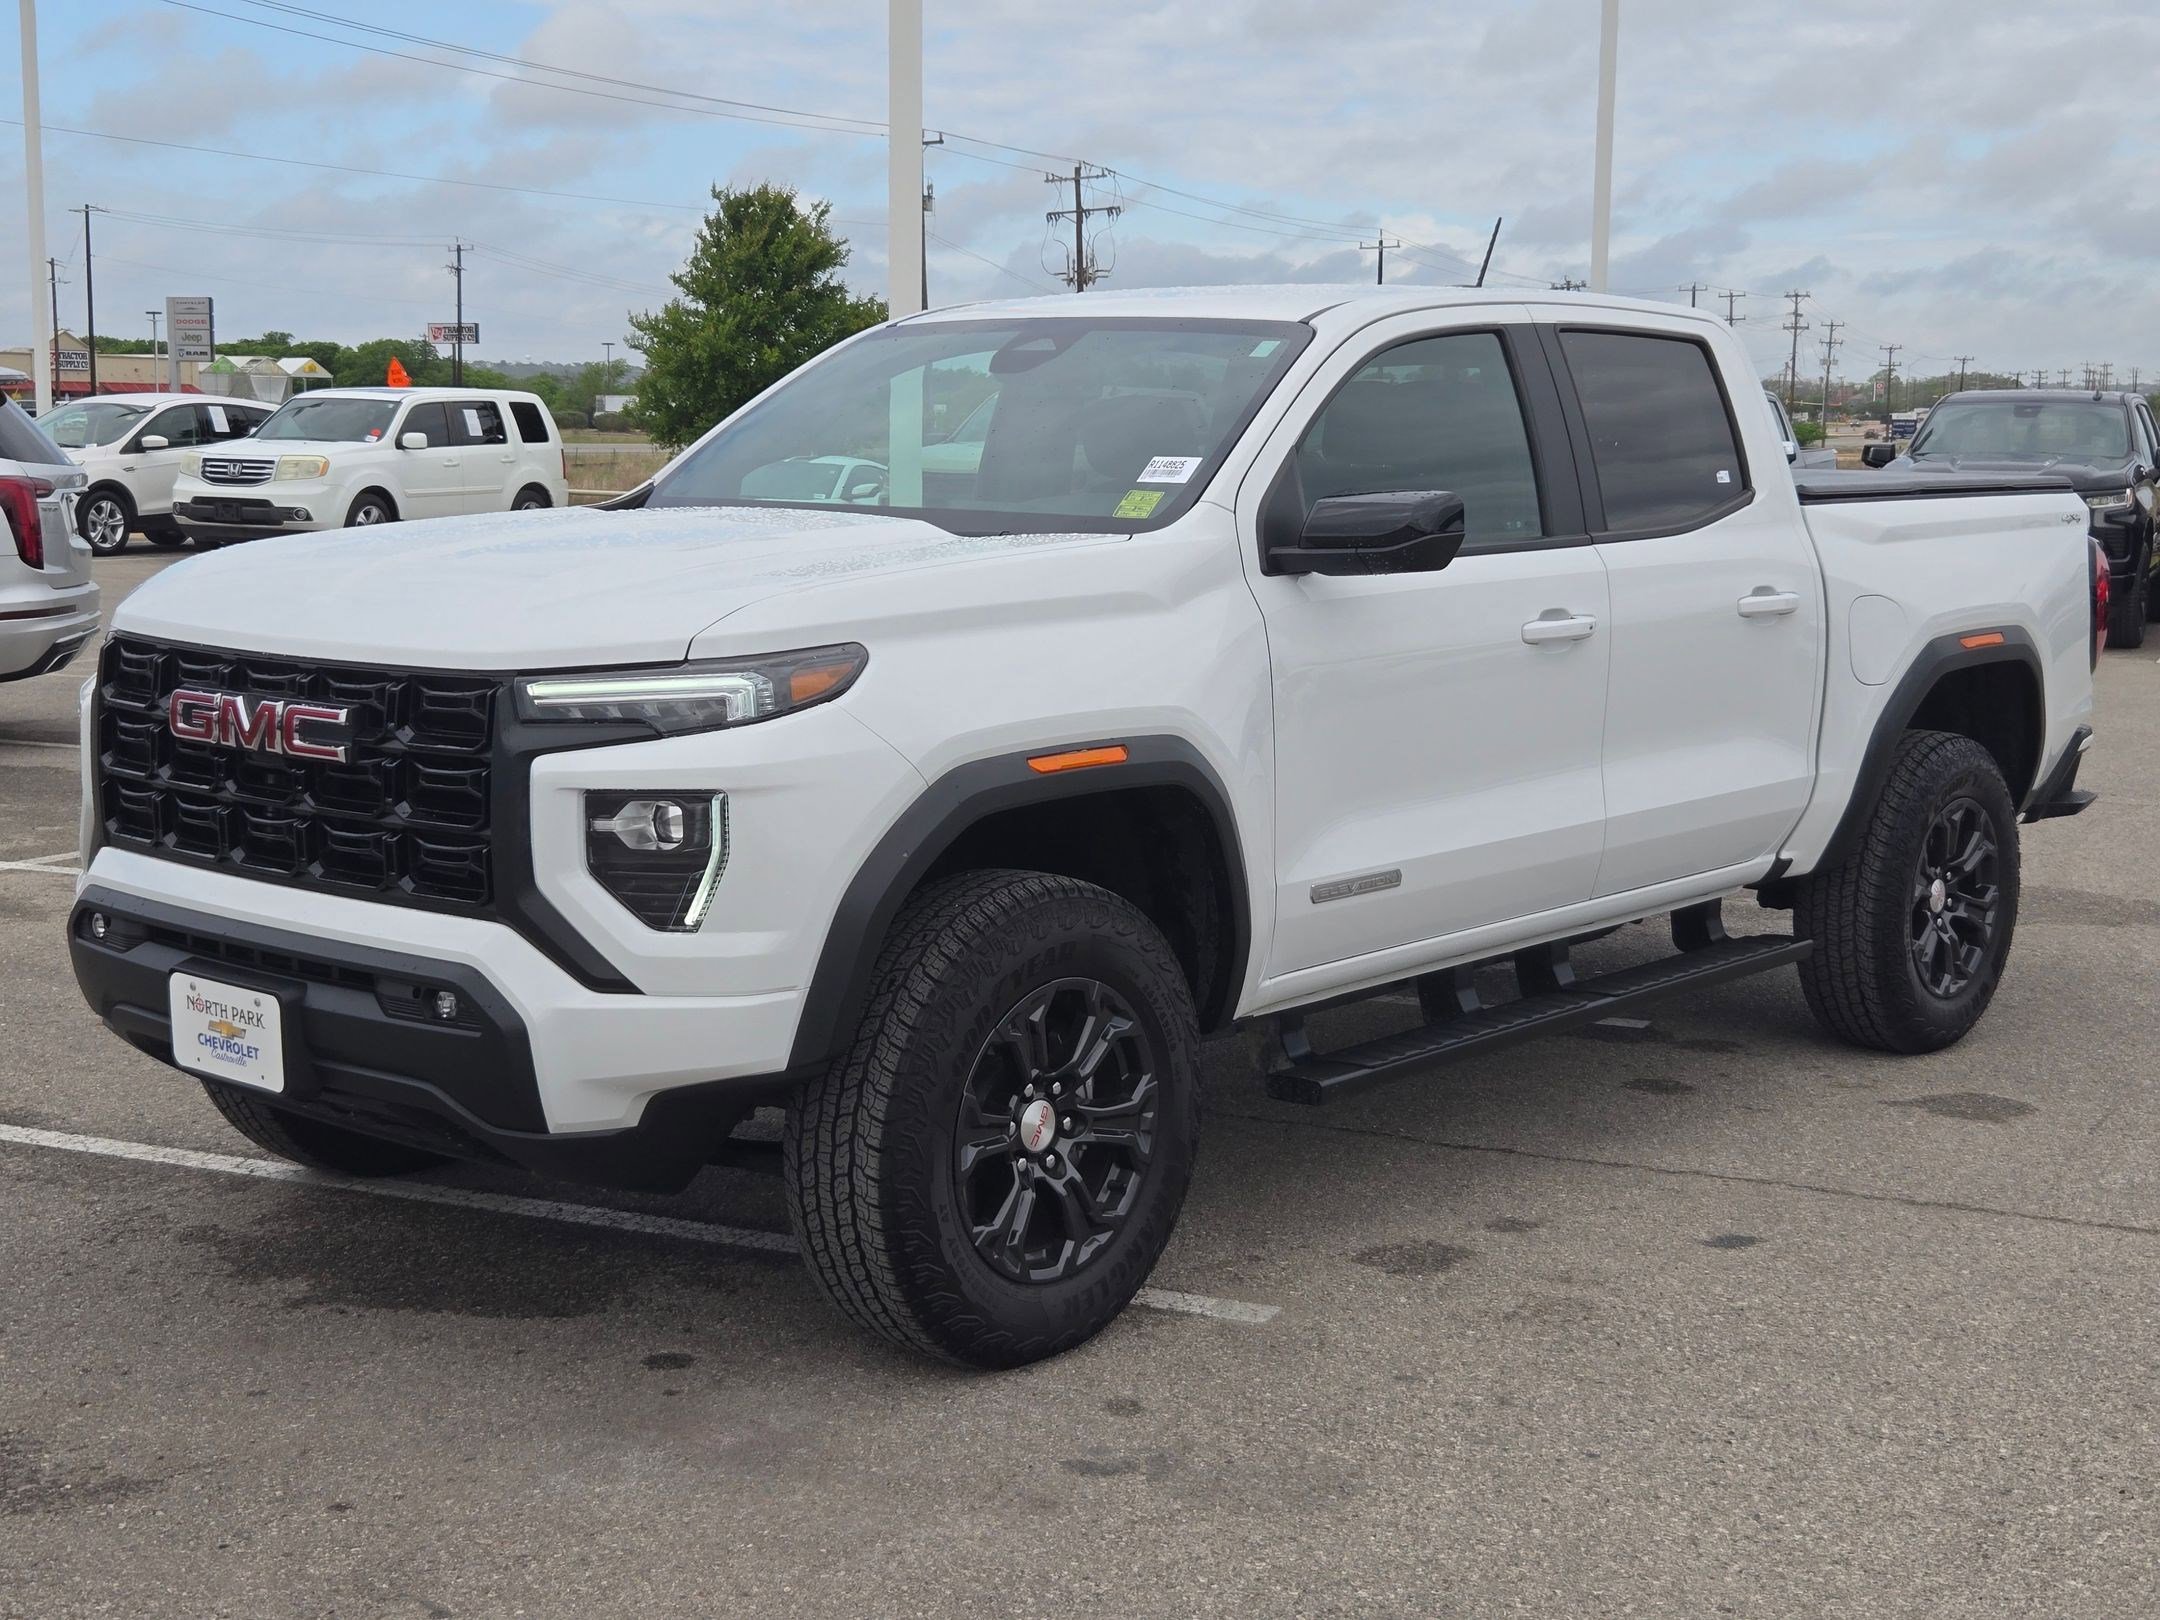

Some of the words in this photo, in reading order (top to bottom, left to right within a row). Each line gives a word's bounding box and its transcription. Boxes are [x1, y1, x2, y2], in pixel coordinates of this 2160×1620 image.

[181, 332, 203, 343] Jeep
[58, 351, 88, 360] TRACTOR
[58, 360, 80, 369] SUPPLY
[169, 689, 348, 763] GMC
[186, 993, 228, 1019] NORTH
[231, 1006, 266, 1029] PARK
[197, 1033, 260, 1060] CHEVROLET
[1030, 1105, 1049, 1147] GMC
